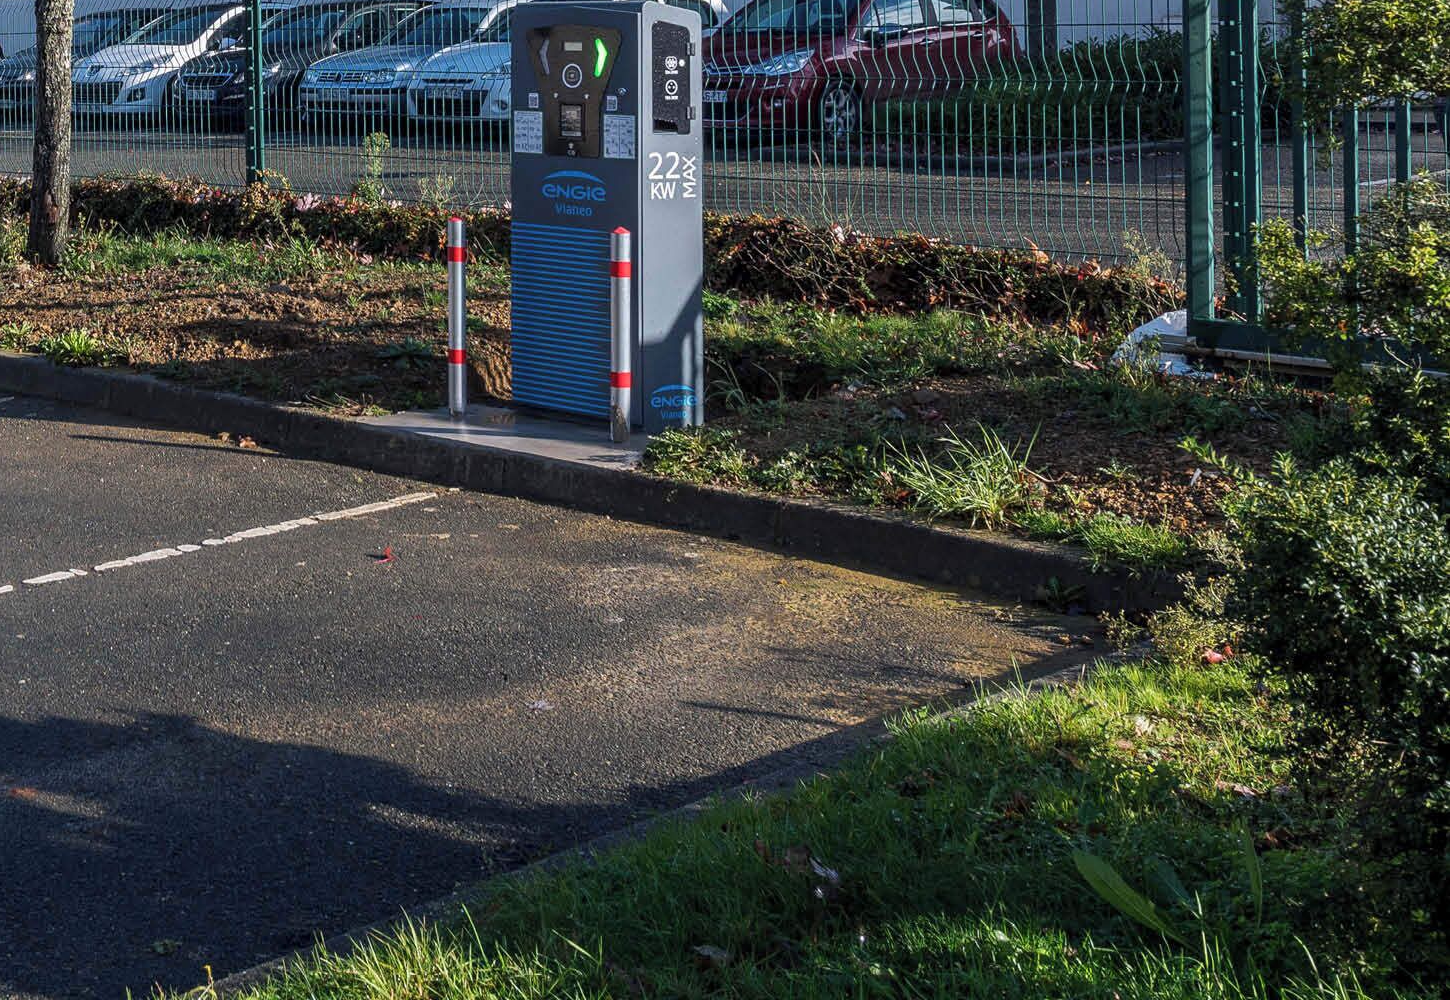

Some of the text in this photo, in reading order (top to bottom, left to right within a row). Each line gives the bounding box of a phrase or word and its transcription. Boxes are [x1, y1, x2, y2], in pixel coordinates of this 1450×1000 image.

[648, 151, 680, 180] 22
[682, 155, 697, 198] MAX
[650, 181, 677, 200] KW
